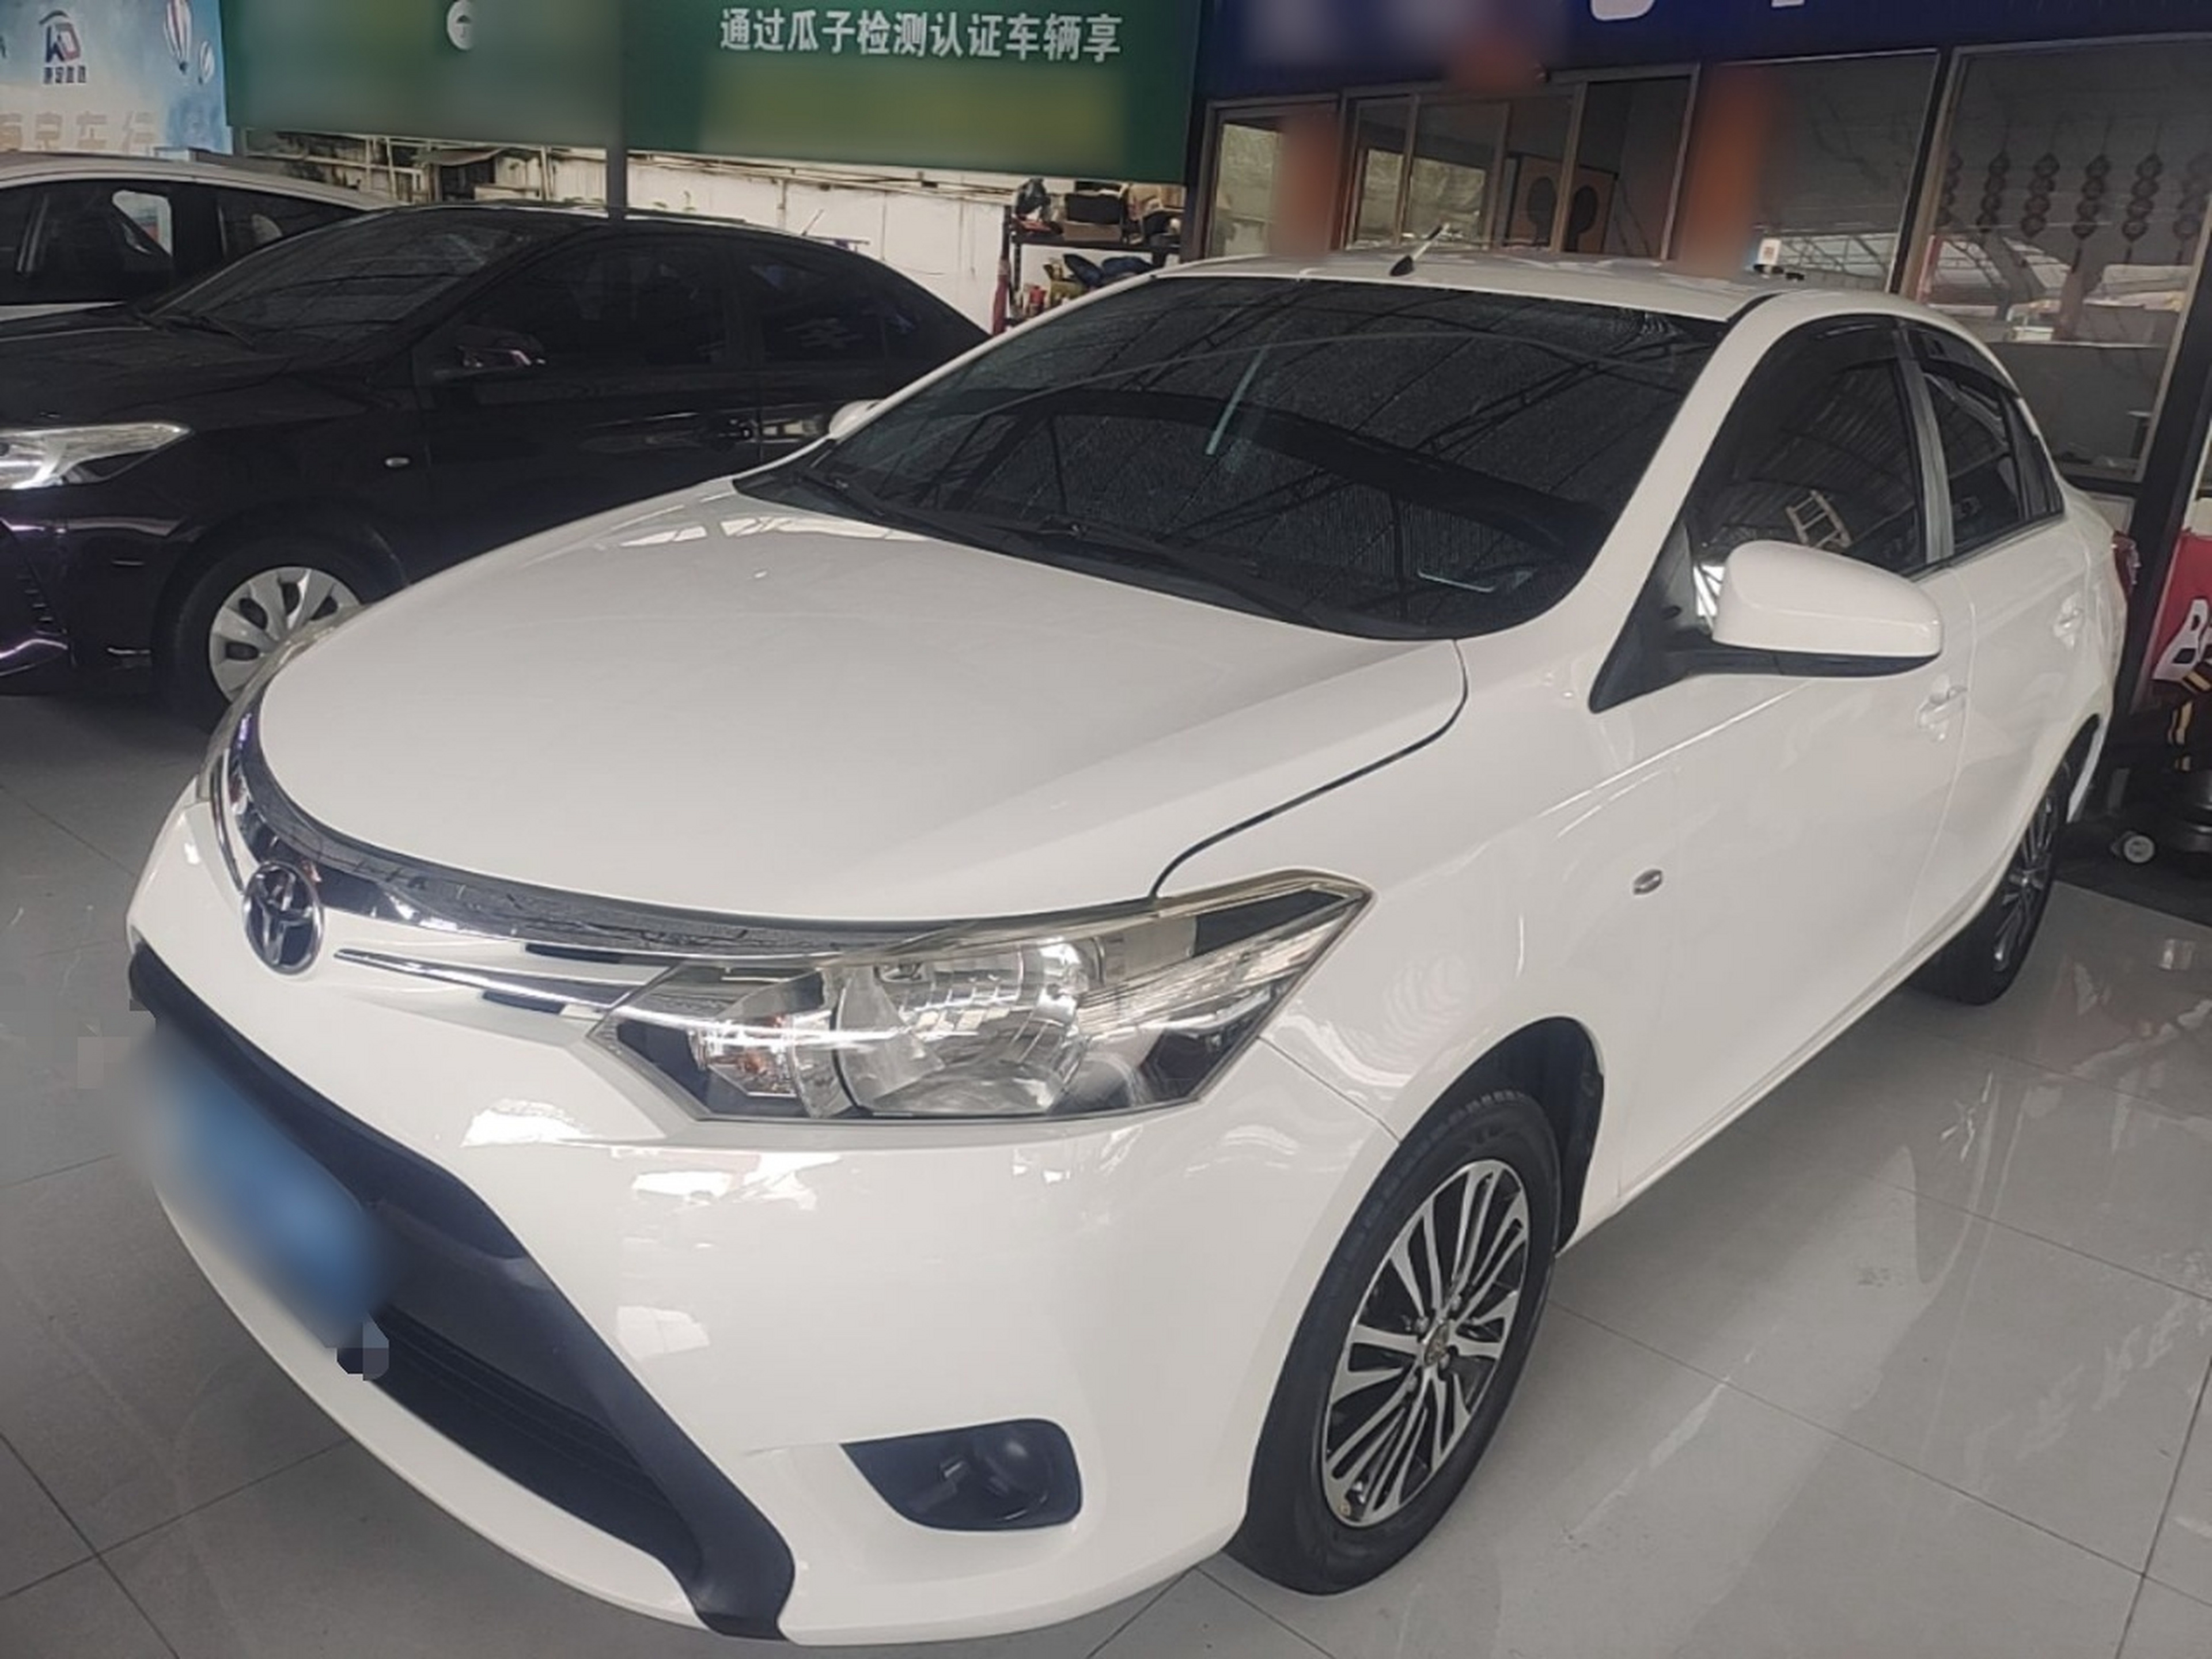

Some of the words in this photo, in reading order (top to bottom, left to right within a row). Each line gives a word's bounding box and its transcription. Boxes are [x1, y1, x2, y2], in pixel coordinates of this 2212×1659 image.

[720, 8, 1123, 63] 通过瓜子检测认证车辆享
